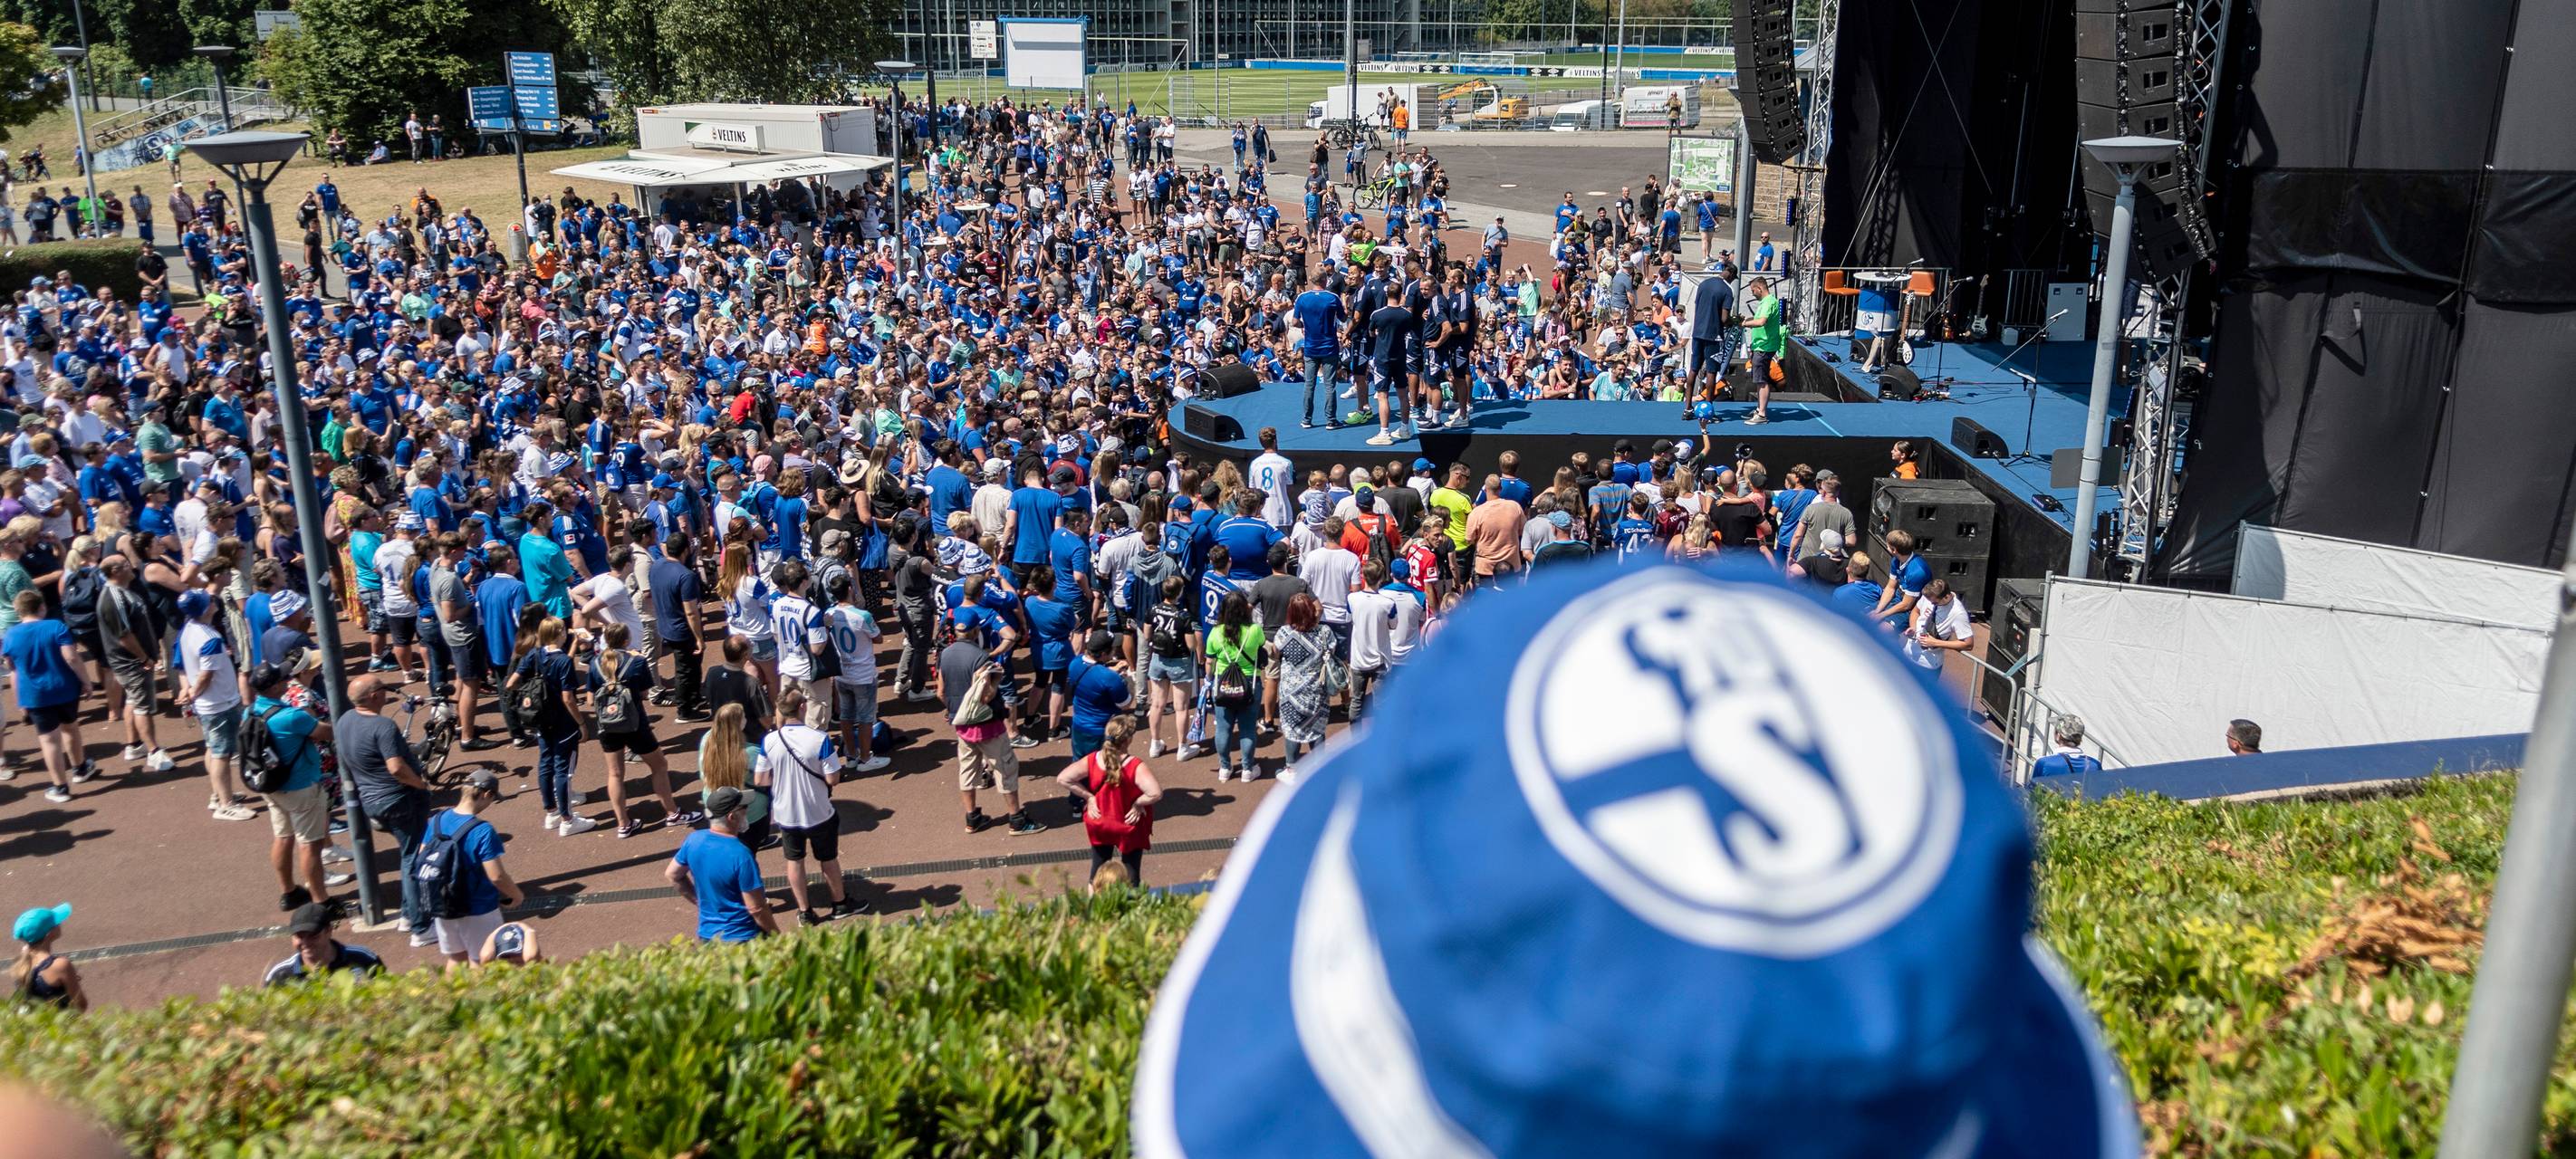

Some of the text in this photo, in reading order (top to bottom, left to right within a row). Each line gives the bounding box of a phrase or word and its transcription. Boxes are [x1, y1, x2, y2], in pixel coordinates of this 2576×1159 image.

[1574, 69, 1600, 77] VELTINS
[717, 129, 746, 143] VELTINS
[617, 165, 682, 179] VELTINS
[775, 164, 827, 173] VELTINS
[1261, 466, 1274, 491] 8
[934, 584, 947, 610] 6
[1206, 589, 1218, 618] 9
[781, 604, 802, 615] SCHALKE
[780, 616, 802, 647] 10
[1153, 614, 1177, 639] 24
